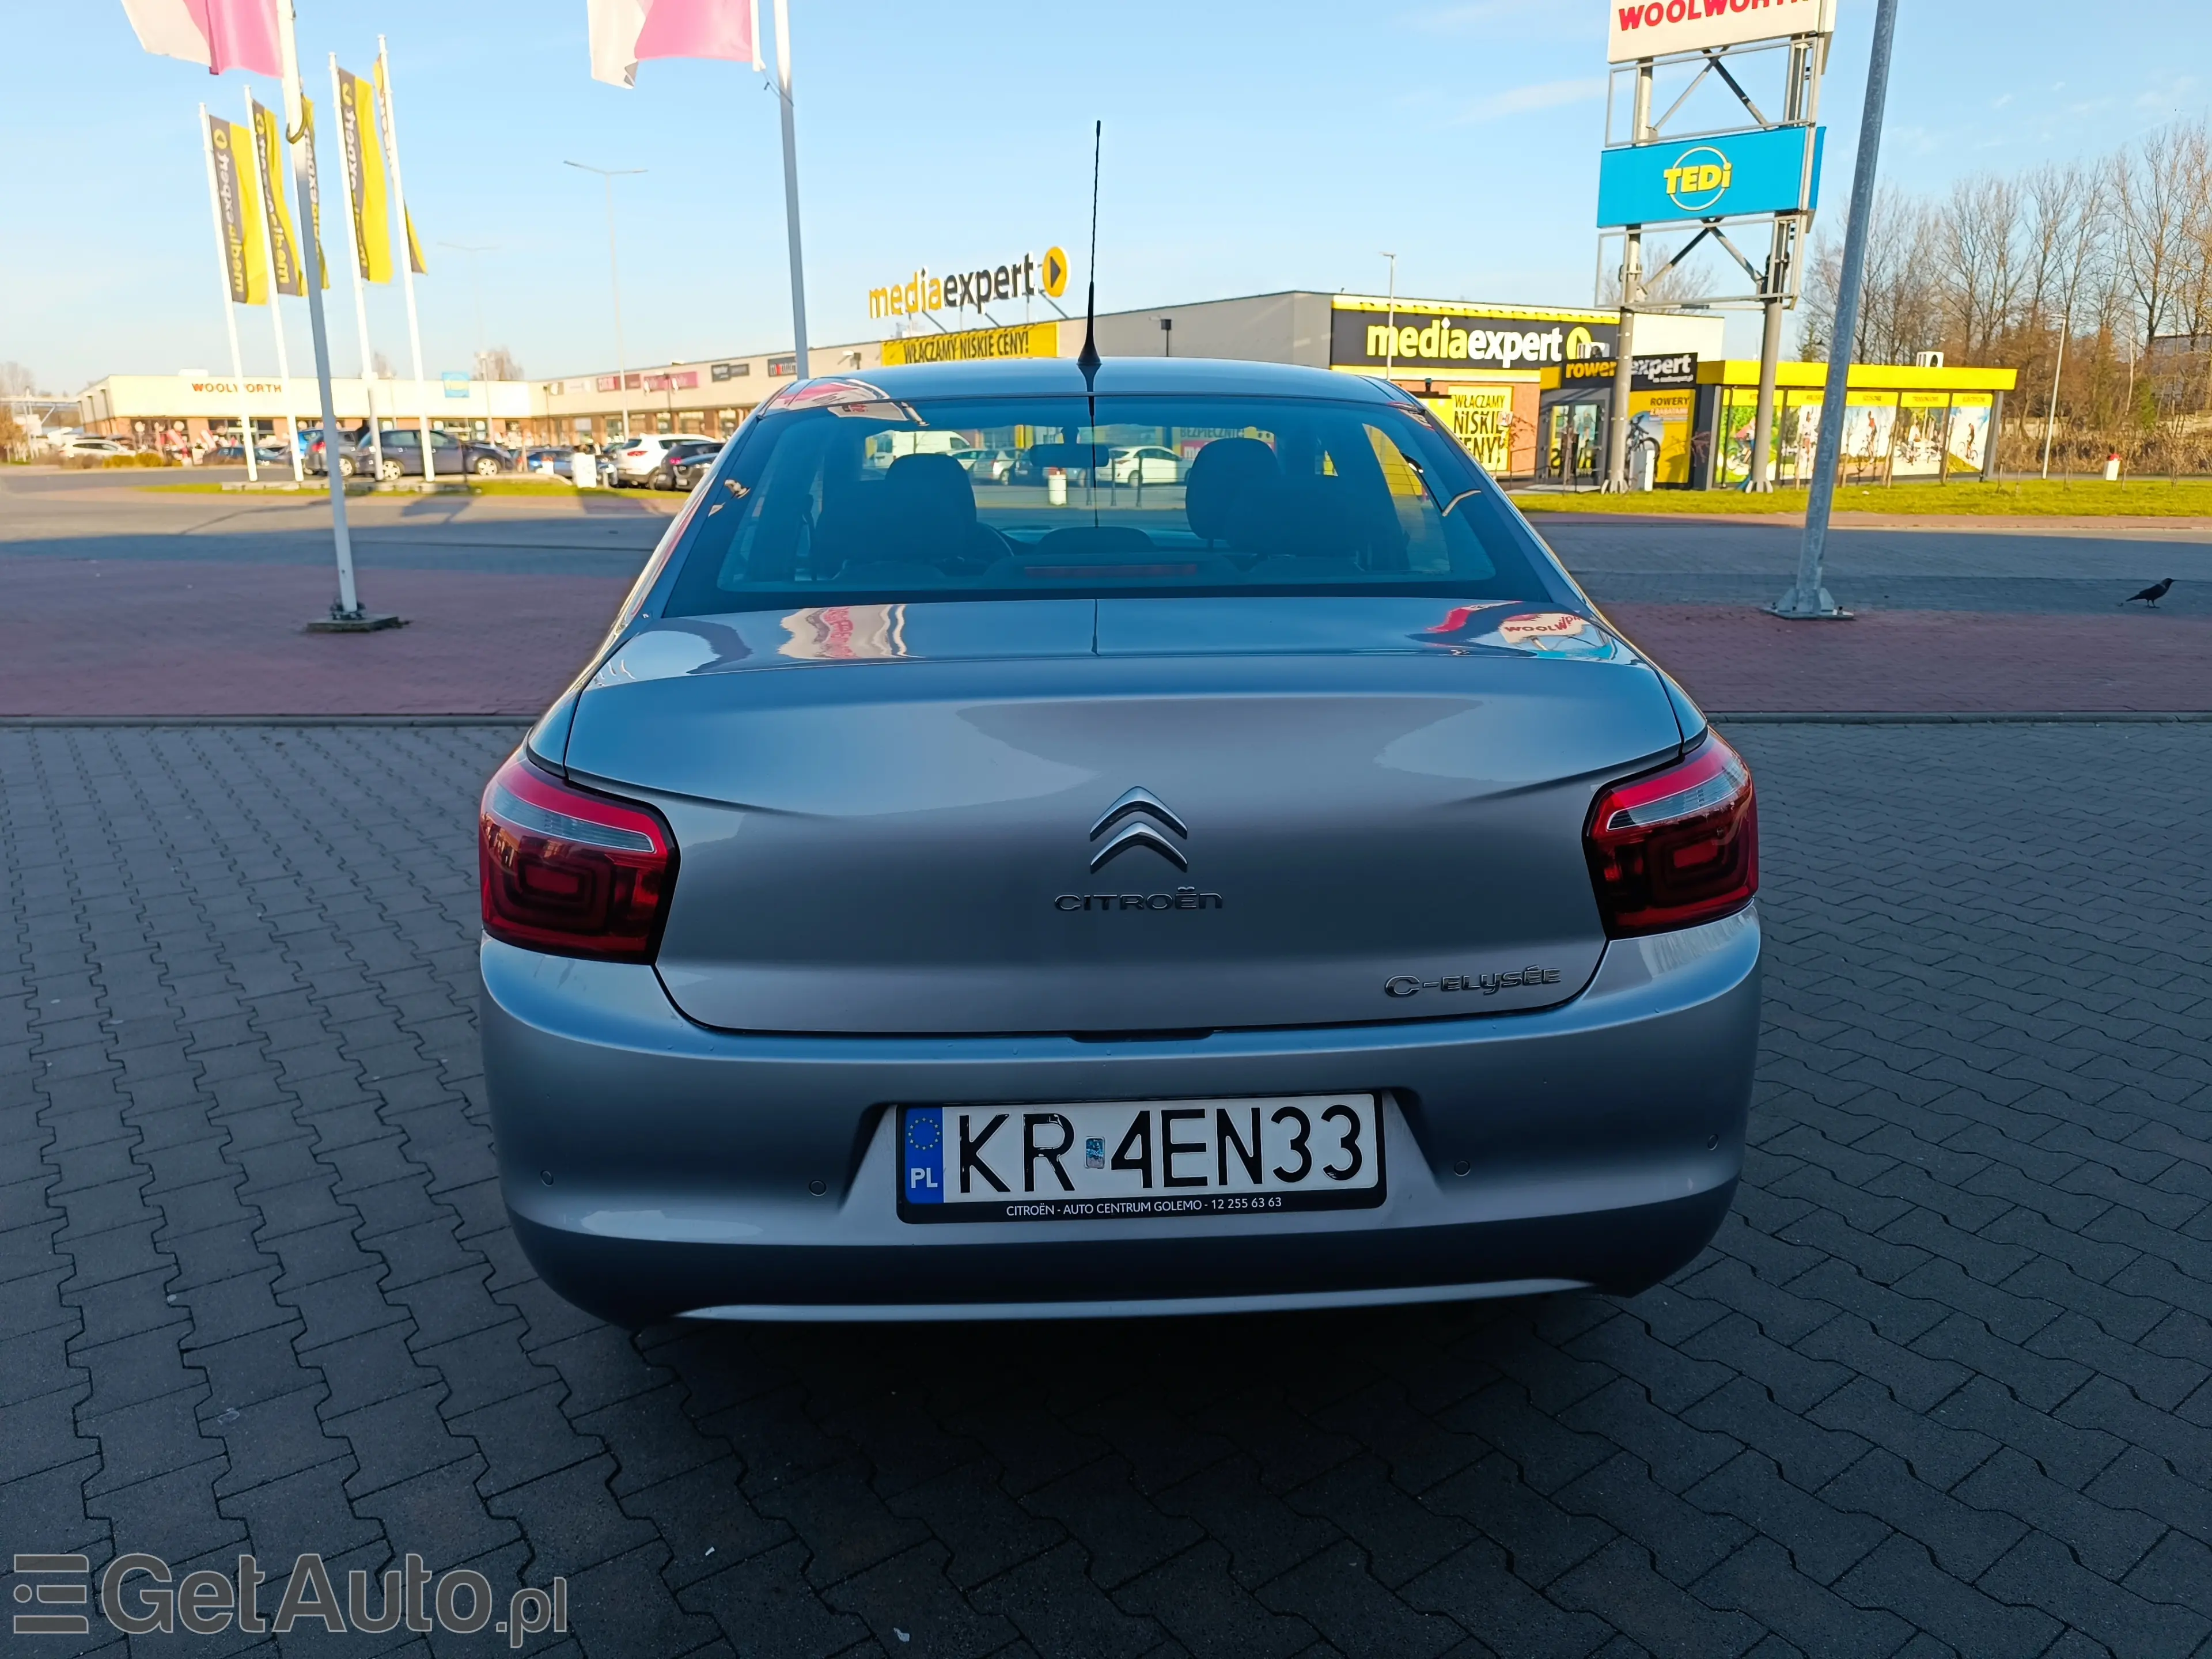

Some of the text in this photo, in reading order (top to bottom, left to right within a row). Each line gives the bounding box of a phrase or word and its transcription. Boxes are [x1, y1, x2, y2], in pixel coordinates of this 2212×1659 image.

[1664, 162, 1732, 194] TEDi
[869, 251, 1037, 319] mediaexpert
[960, 335, 994, 359] NISKIE
[997, 331, 1029, 355] CENY!
[1367, 317, 1563, 368] mediaexpert
[1650, 396, 1690, 406] ROWERY
[959, 1104, 1363, 1193] KR 4EN33
[911, 1168, 938, 1188] PL
[1006, 1203, 1055, 1216] CITROËN
[1063, 1204, 1094, 1215] AUTO
[1097, 1201, 1151, 1214] CENTRUM
[1154, 1200, 1202, 1211] GOLEMO
[1211, 1199, 1224, 1209] 12
[1228, 1198, 1248, 1209] 255
[1251, 1198, 1264, 1207] 63
[1268, 1197, 1282, 1207] 63
